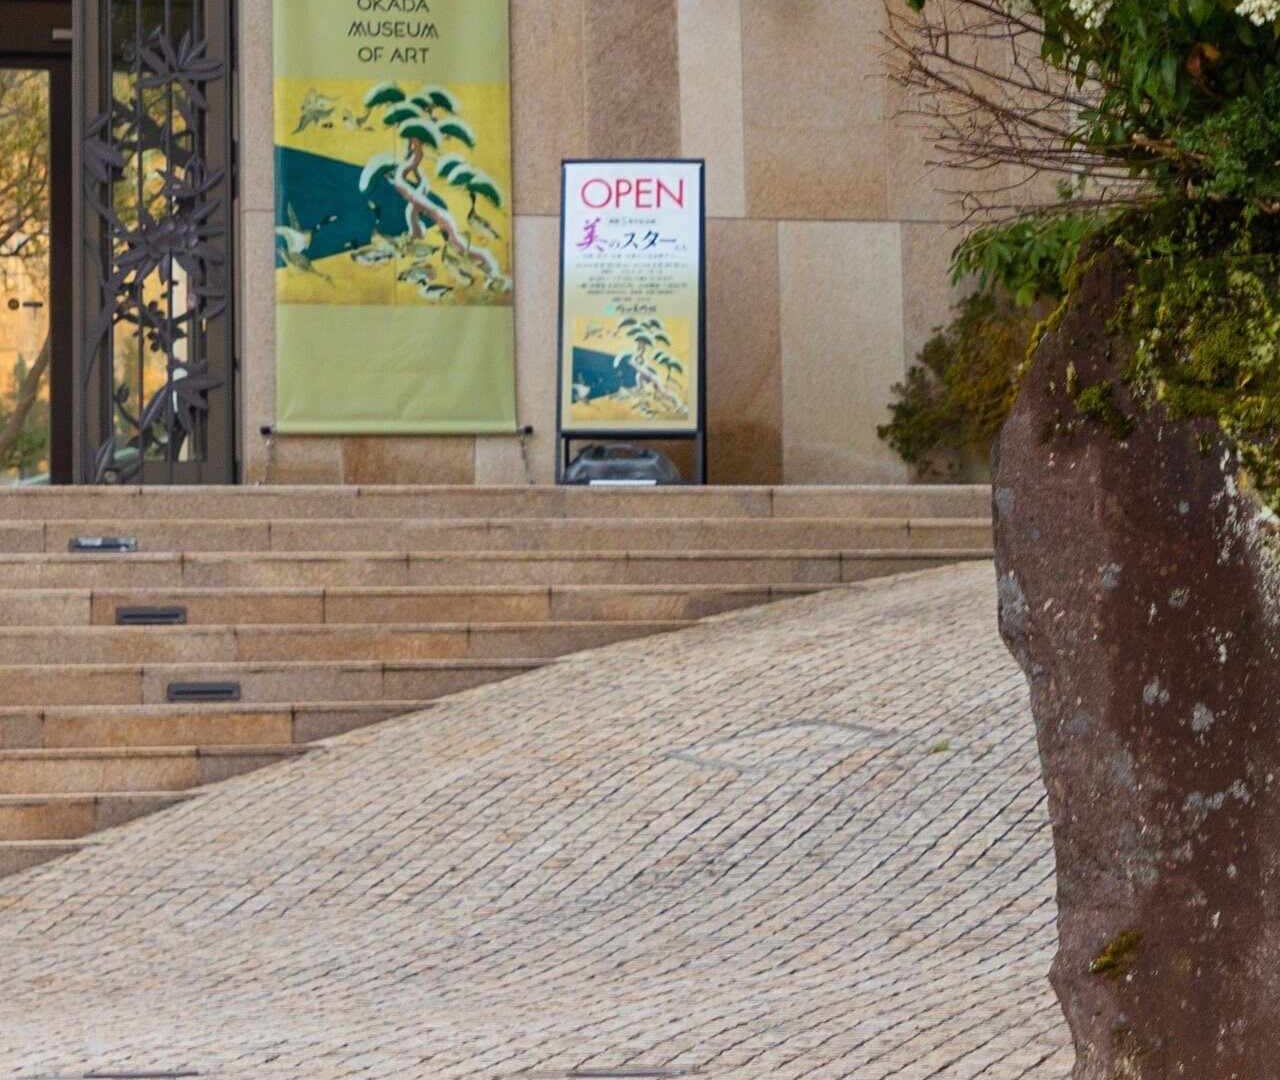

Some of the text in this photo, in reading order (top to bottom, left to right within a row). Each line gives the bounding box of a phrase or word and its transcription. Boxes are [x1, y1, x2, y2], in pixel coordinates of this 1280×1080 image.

[347, 20, 439, 39] MUSEUM
[358, 46, 430, 64] OF ART
[581, 178, 684, 209] OPEN
